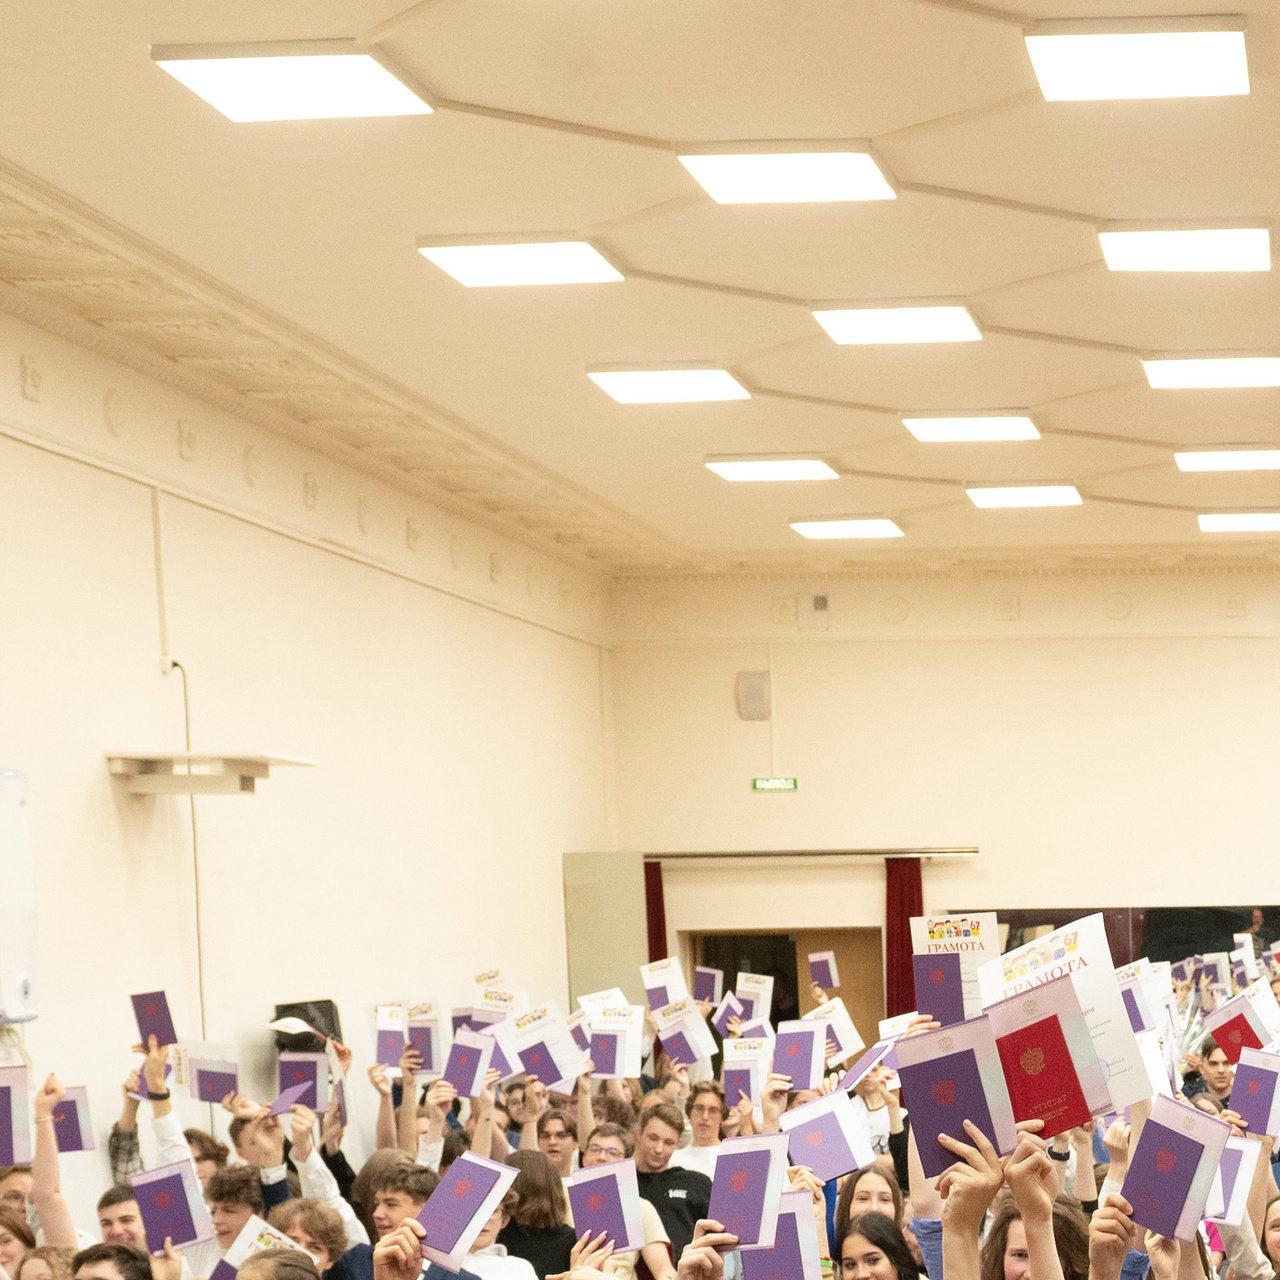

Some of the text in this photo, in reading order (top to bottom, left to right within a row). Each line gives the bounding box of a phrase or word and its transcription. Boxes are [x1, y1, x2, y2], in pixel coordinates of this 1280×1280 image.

[970, 920, 980, 931] 67
[1064, 931, 1079, 947] 67
[927, 941, 985, 953] ГРАМОТА
[1003, 957, 1089, 999] ГРАМОТА
